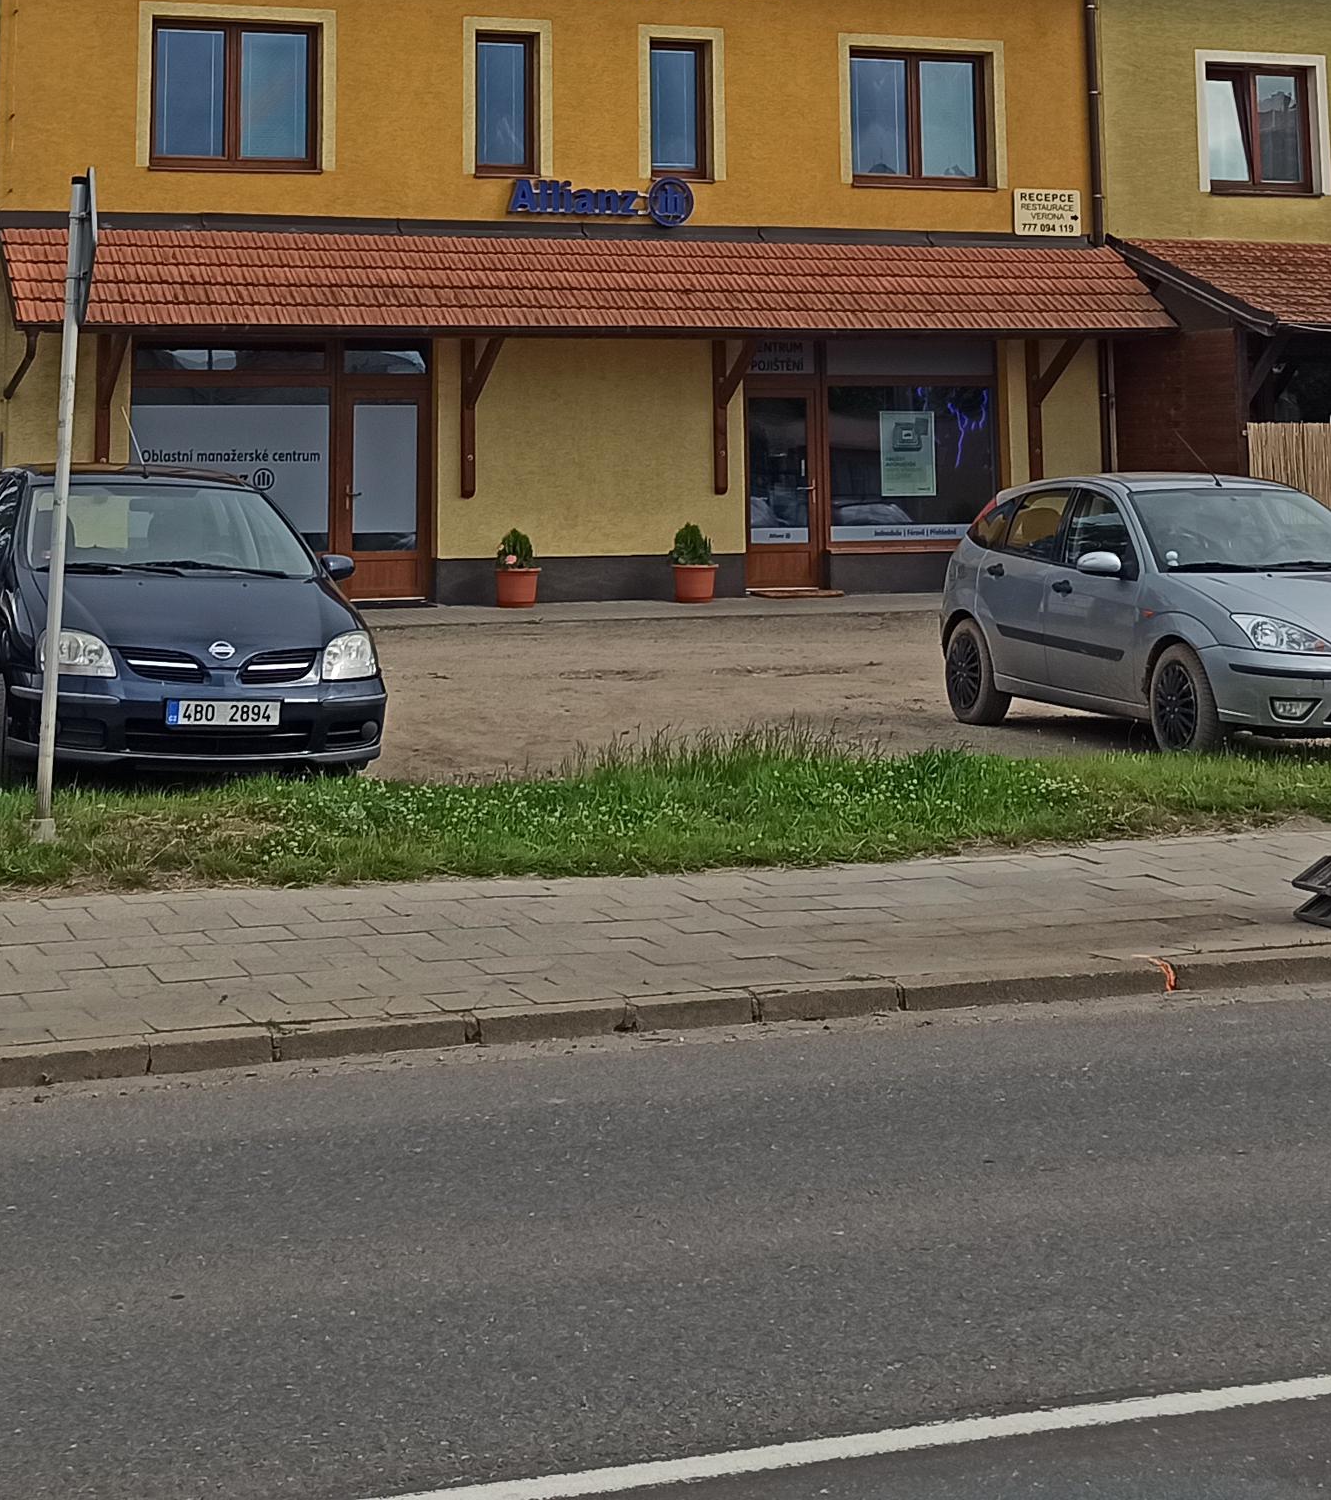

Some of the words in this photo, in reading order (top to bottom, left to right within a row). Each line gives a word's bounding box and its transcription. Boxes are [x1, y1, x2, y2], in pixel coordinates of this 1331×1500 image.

[508, 179, 640, 215] Allianz
[1020, 192, 1074, 202] RECEPCE
[1020, 203, 1074, 212] RESTAURACE
[1030, 212, 1065, 220] VERONA
[1022, 223, 1037, 232] 777
[1040, 223, 1056, 232] 094
[1059, 224, 1074, 233] 119
[141, 449, 193, 463] Oblastní
[197, 449, 269, 463] manažerské
[272, 450, 321, 463] centrum
[183, 703, 215, 722] 4B0
[229, 704, 271, 722] 2894
